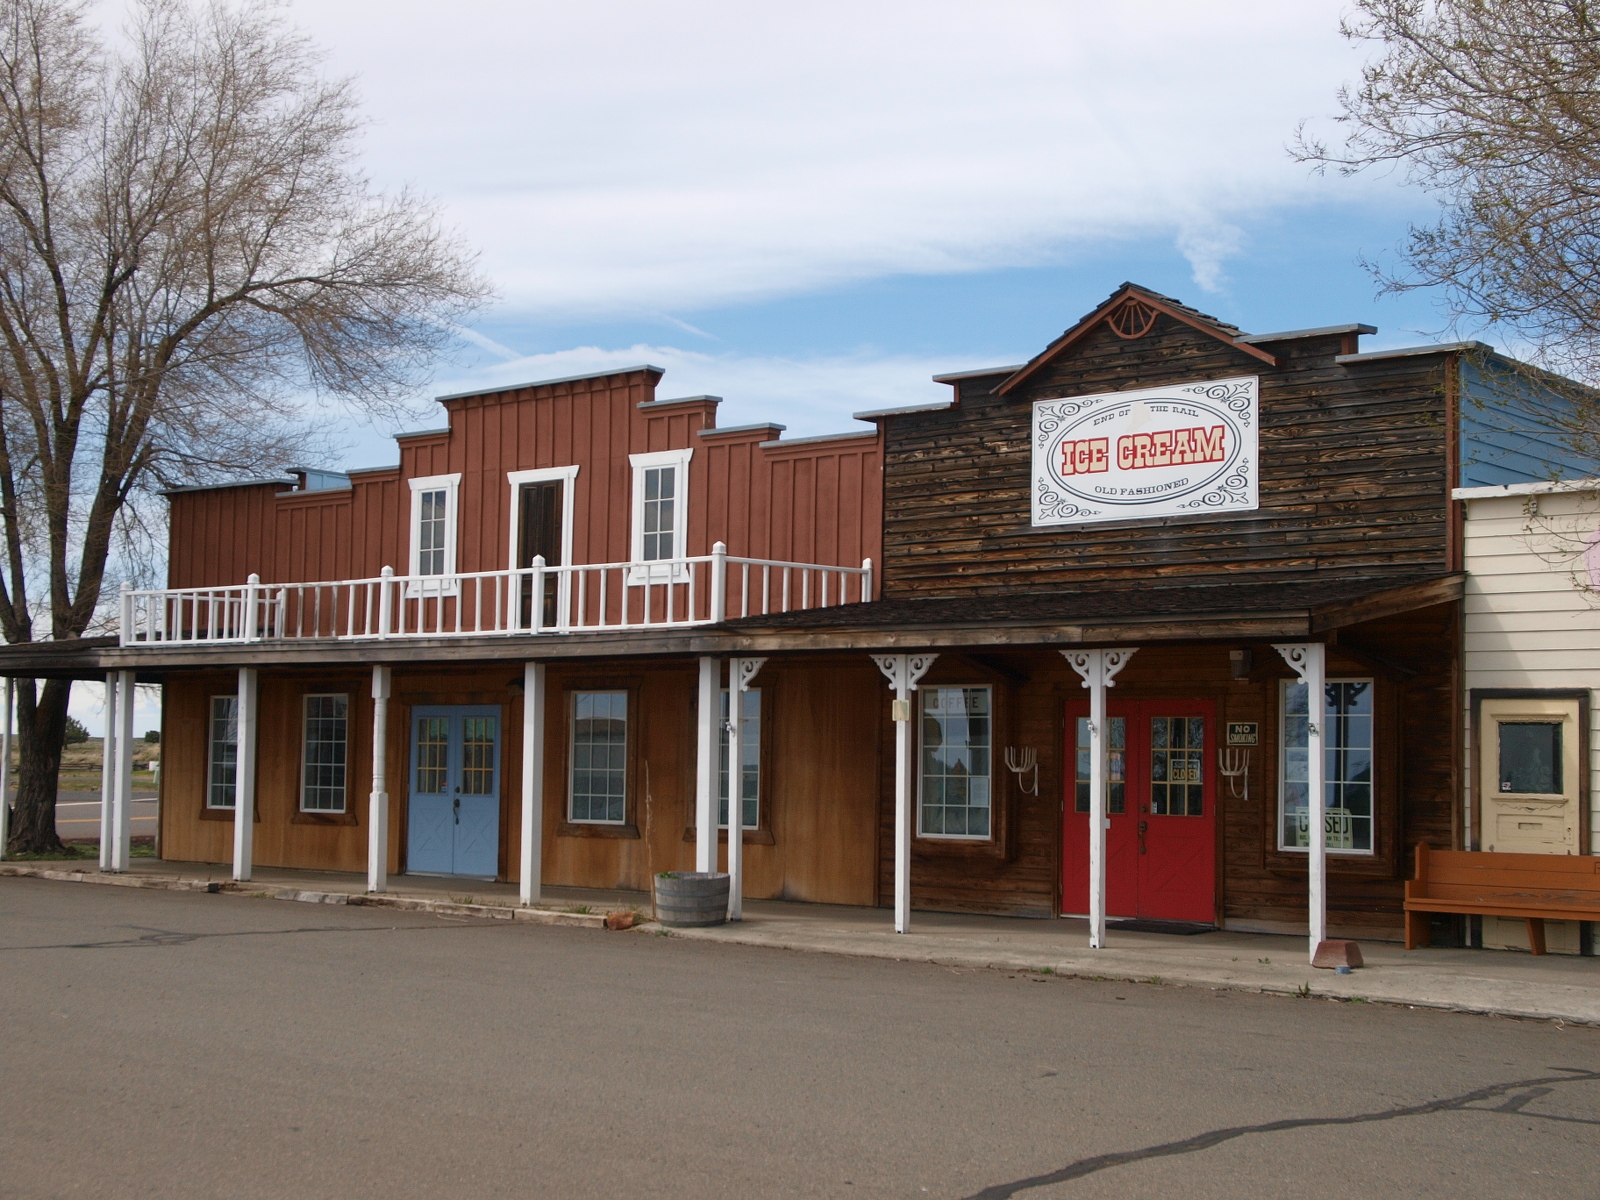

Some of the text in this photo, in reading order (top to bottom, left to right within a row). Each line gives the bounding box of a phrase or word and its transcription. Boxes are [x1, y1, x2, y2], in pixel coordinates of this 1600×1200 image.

[1093, 413, 1115, 426] END
[1119, 409, 1131, 417] OF
[1172, 406, 1199, 417] RAIL
[1062, 424, 1225, 476] ICE CREAM
[1094, 478, 1189, 495] OLD FASHIONED
[933, 696, 979, 709] COFFEE
[1235, 725, 1251, 733] NO
[1230, 733, 1256, 744] SMOKING
[1173, 768, 1198, 780] CLOED
[1299, 811, 1349, 834] CSED
